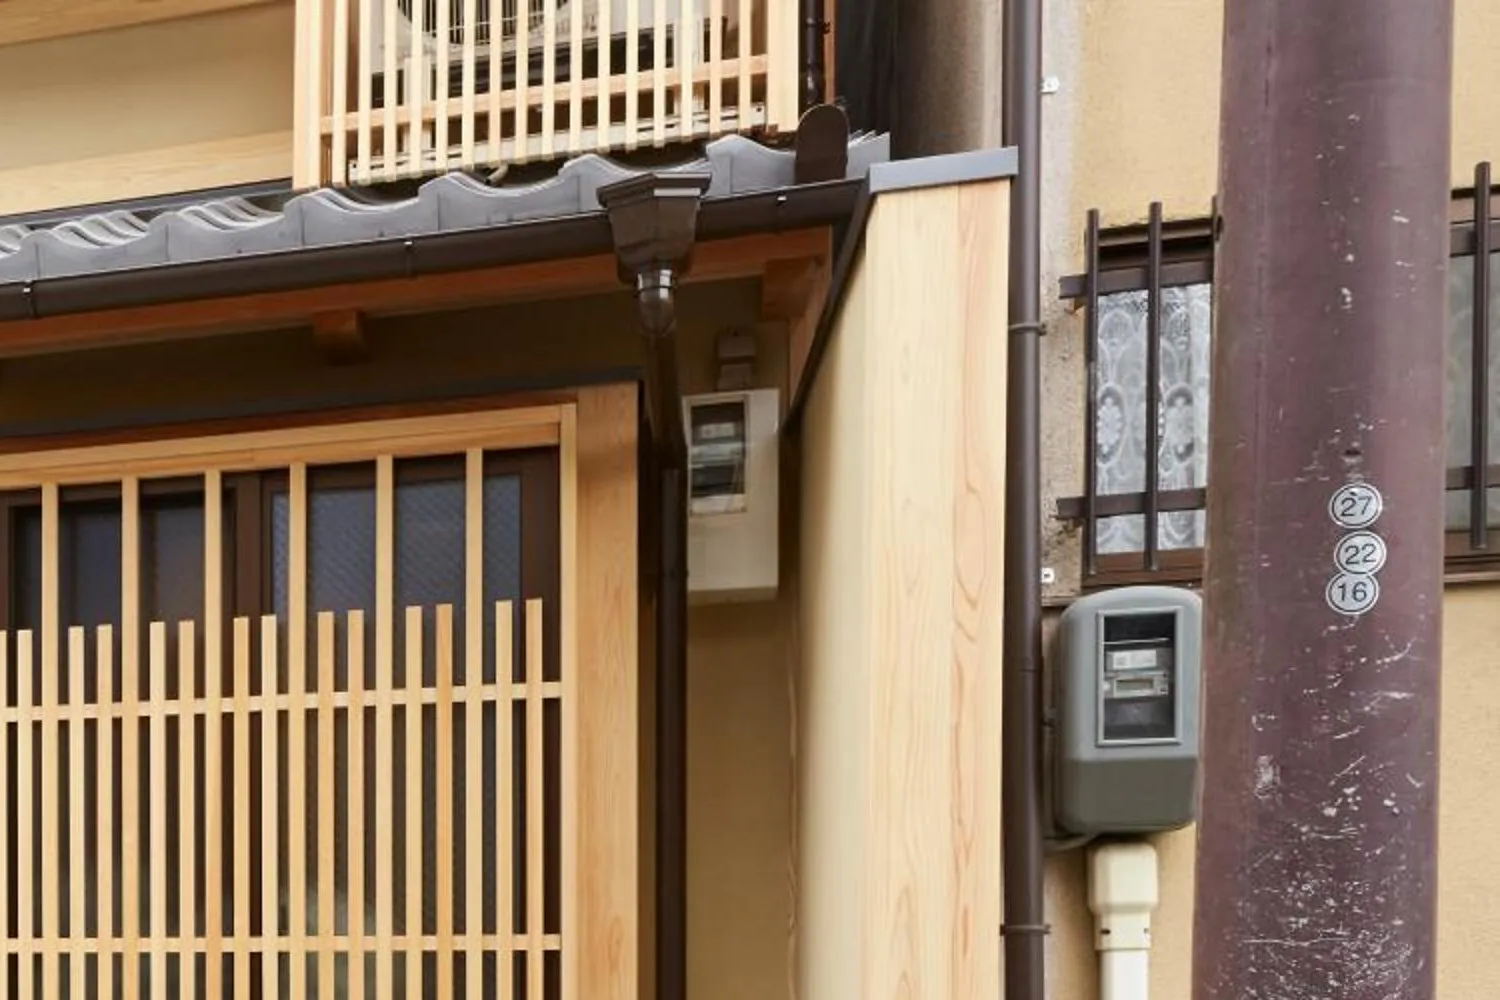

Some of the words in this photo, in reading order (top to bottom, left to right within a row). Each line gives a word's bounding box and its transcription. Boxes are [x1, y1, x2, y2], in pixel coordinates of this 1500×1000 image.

[1340, 495, 1372, 517] 27
[1345, 543, 1377, 565] 22
[1338, 581, 1367, 602] 16
